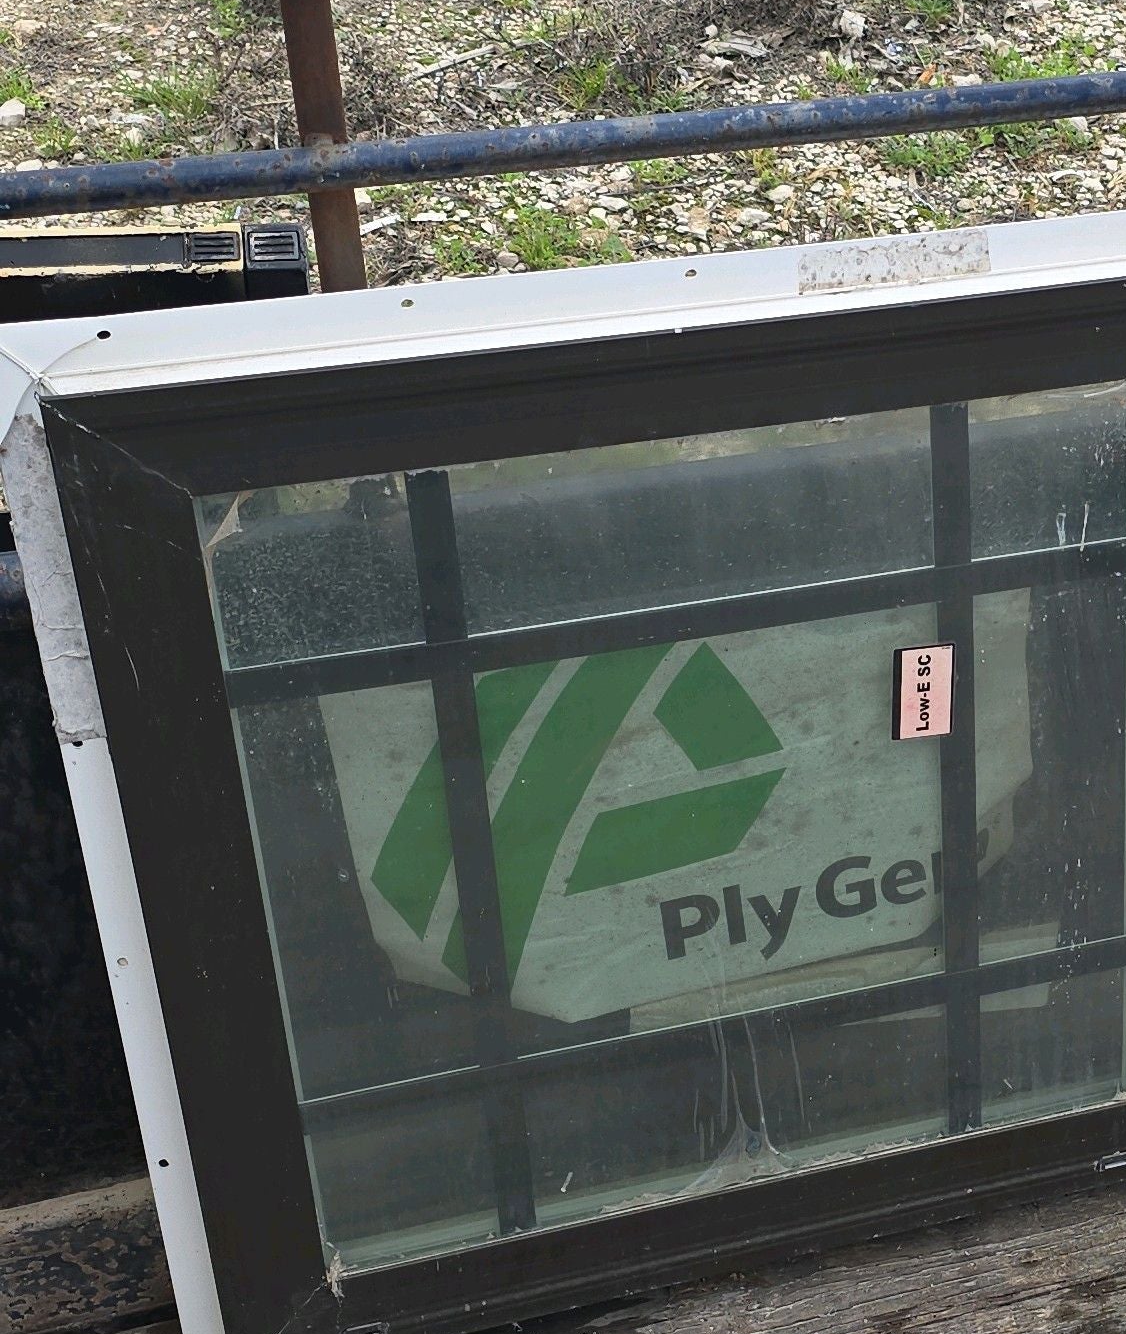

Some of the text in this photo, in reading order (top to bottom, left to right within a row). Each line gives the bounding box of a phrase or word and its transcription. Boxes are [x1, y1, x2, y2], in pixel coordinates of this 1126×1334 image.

[916, 654, 932, 732] Low-E SC
[660, 884, 802, 961] Ply
